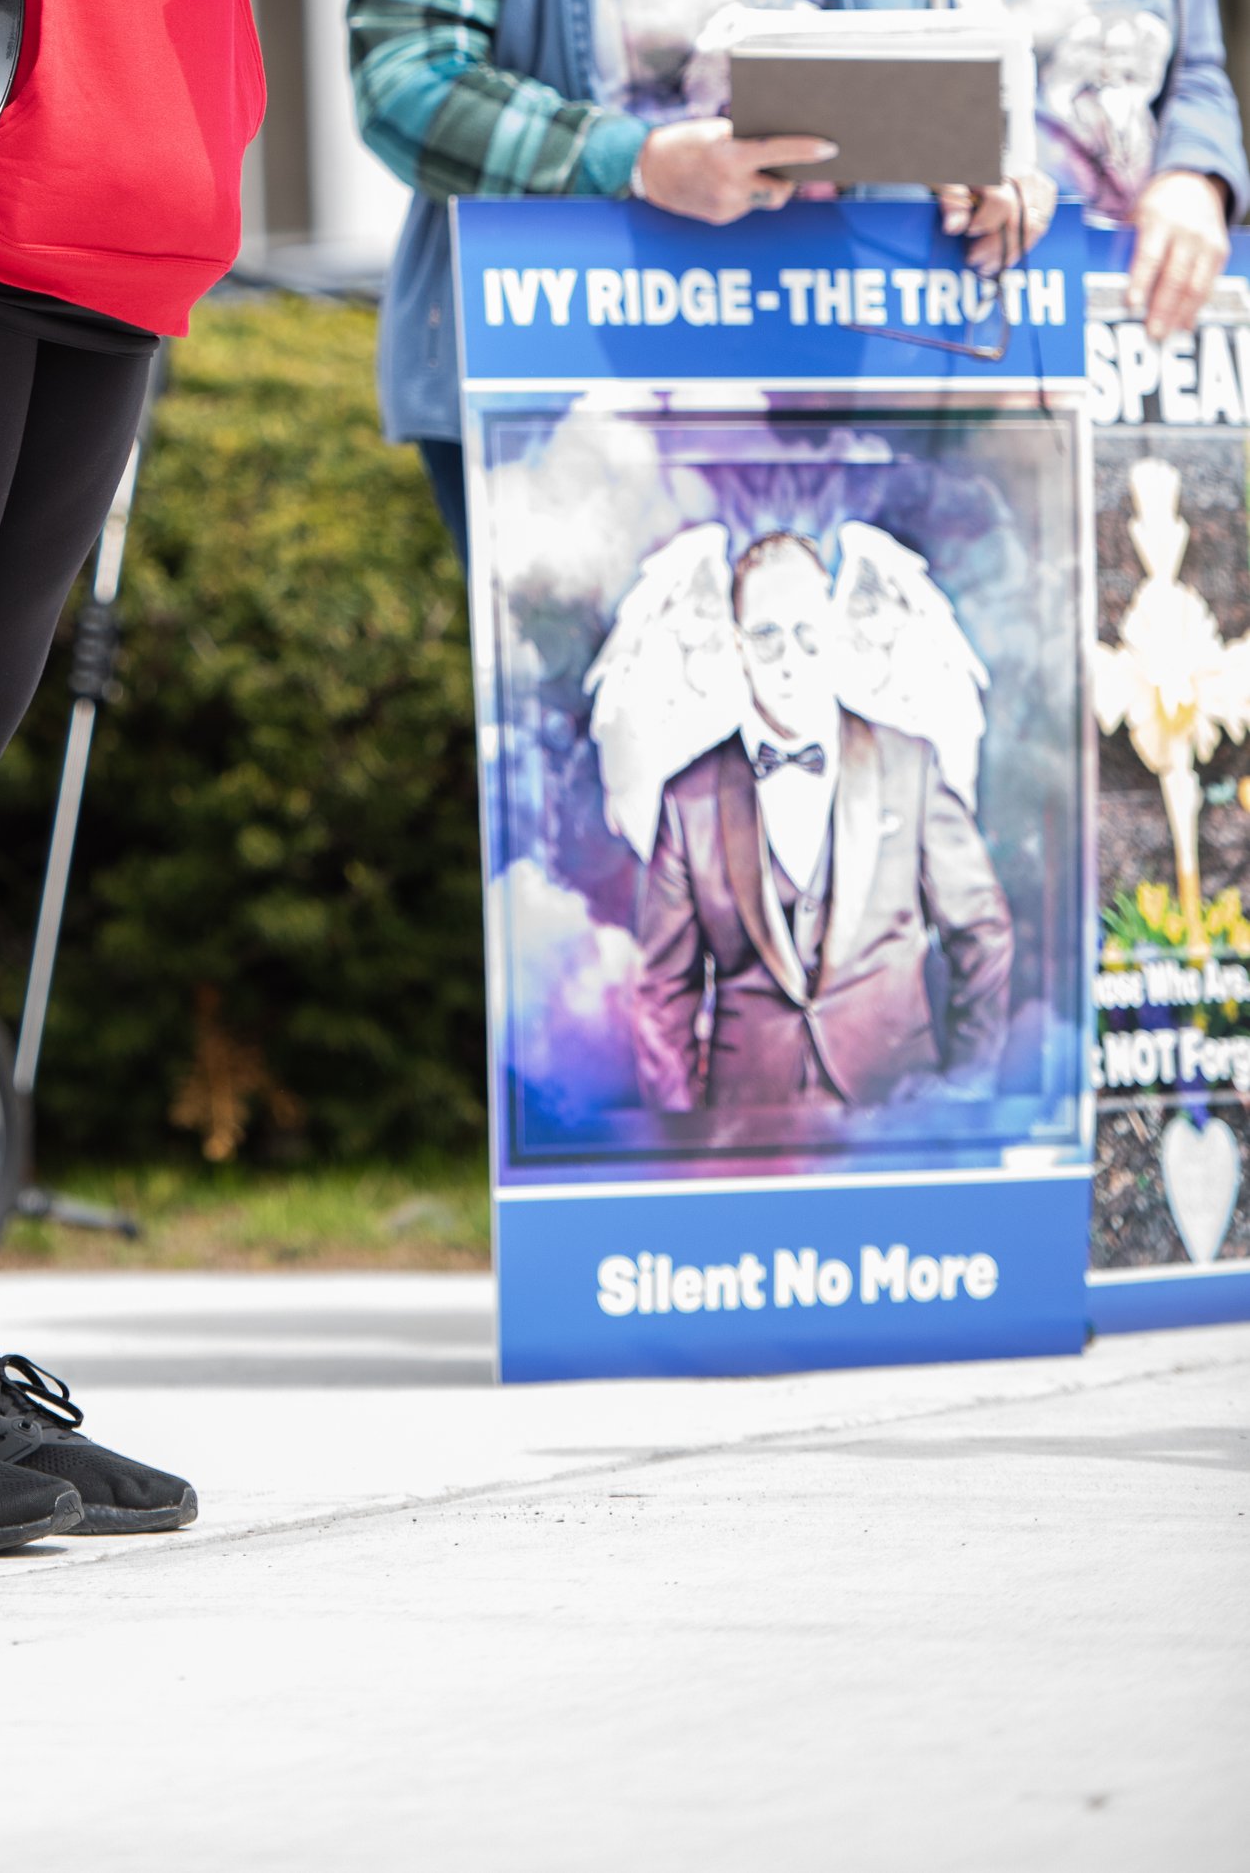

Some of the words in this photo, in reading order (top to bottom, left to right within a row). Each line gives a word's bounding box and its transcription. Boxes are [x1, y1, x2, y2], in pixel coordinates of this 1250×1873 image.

[483, 267, 578, 326] IVY
[586, 267, 753, 327] RIDGE
[779, 267, 888, 326] THE
[892, 267, 1067, 327] TRUTH
[1084, 321, 1250, 426] SPEA
[1104, 1029, 1178, 1088] NOT
[596, 1250, 768, 1317] Silent
[773, 1247, 854, 1310] No
[859, 1243, 1000, 1305] More
